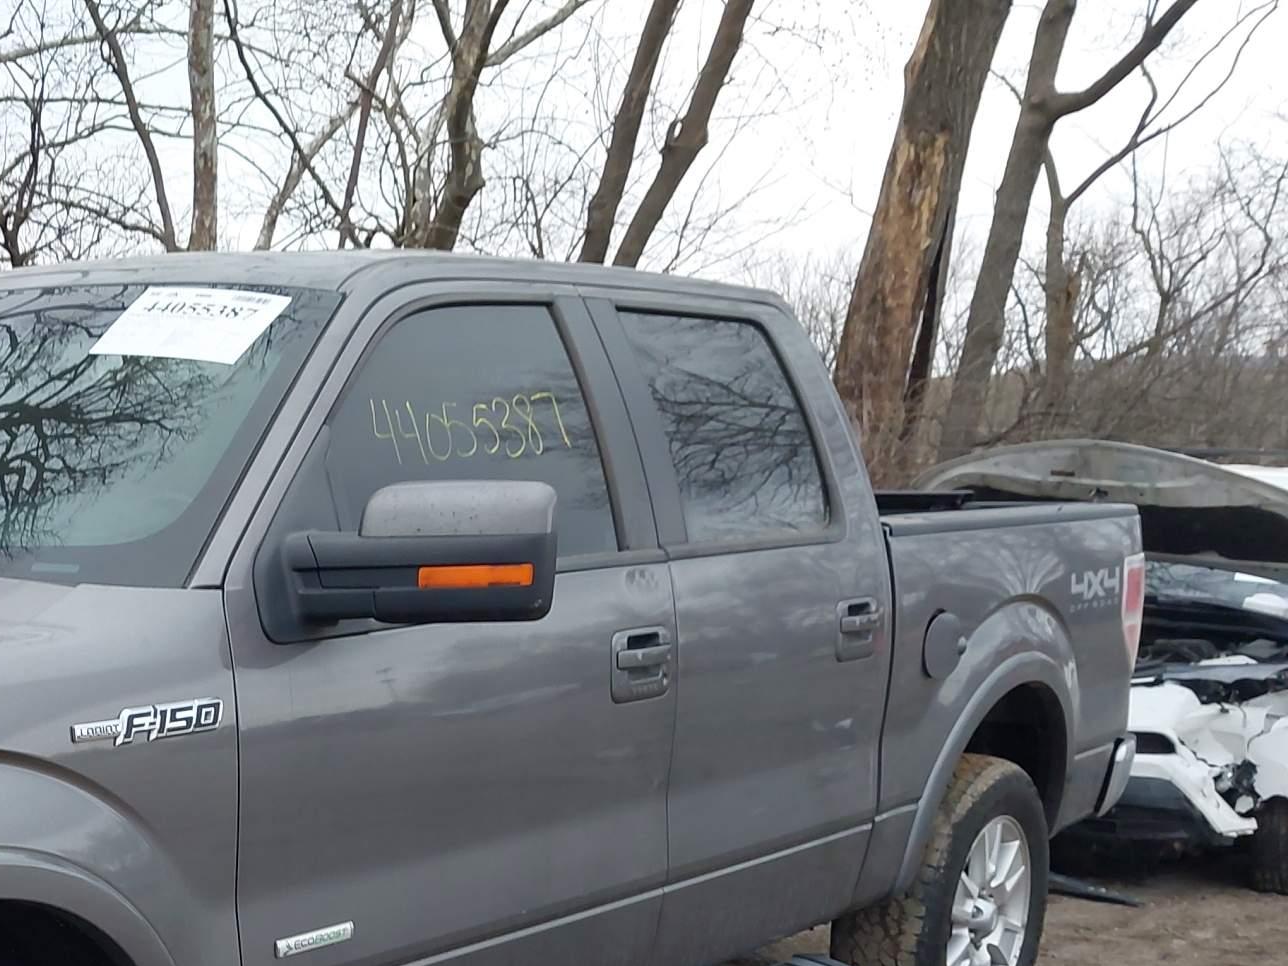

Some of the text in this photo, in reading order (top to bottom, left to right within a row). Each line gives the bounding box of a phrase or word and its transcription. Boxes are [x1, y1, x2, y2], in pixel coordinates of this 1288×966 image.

[143, 301, 259, 321] 44055387
[370, 392, 572, 464] 44055387
[113, 699, 223, 746] F-150
